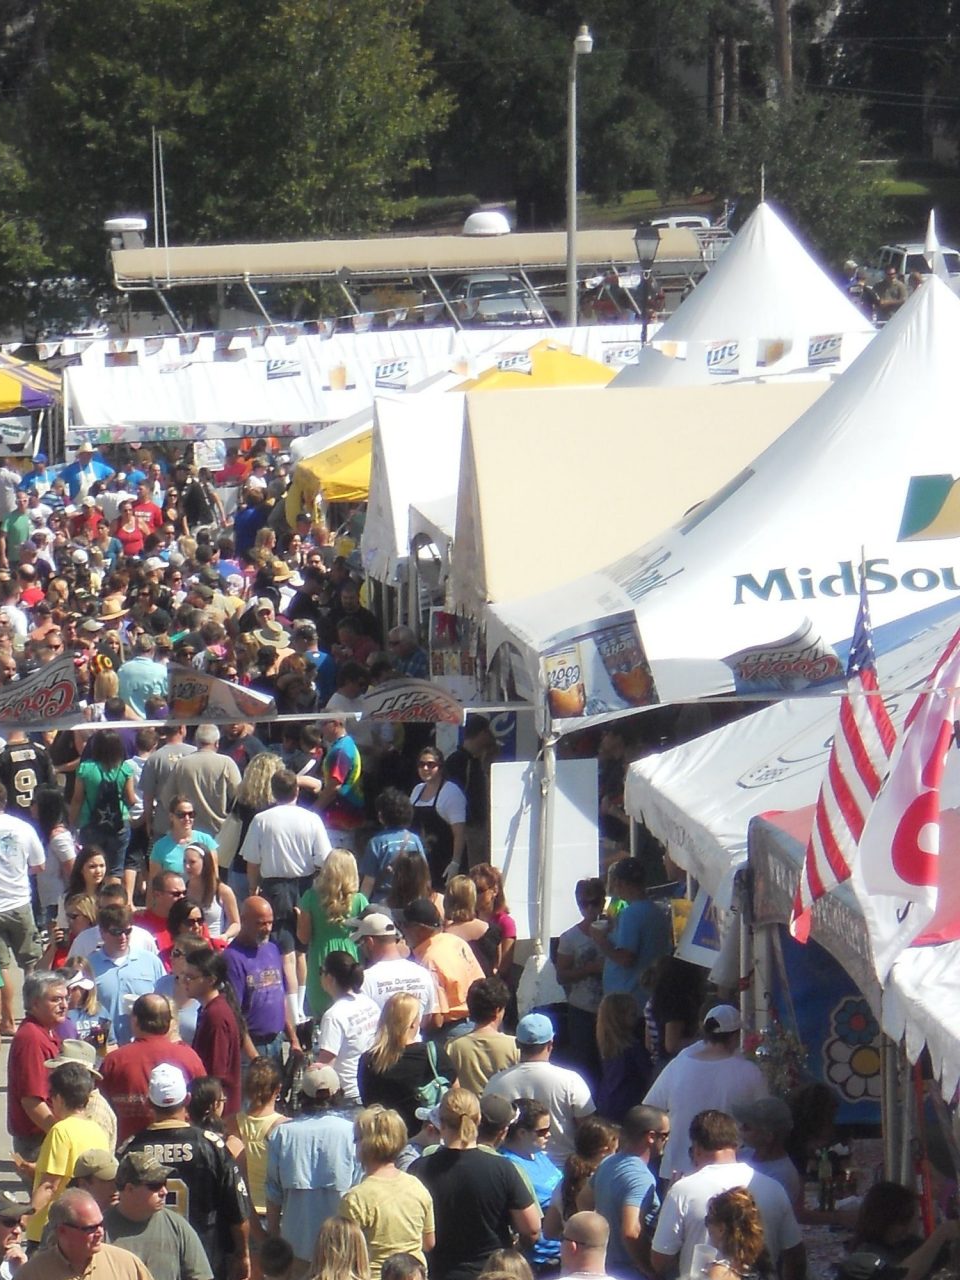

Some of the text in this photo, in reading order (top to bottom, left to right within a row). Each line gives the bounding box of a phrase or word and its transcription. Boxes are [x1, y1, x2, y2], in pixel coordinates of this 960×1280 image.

[707, 341, 739, 366] Lite
[375, 360, 409, 380] Lite
[740, 653, 837, 681] Coors
[14, 768, 38, 808] 9
